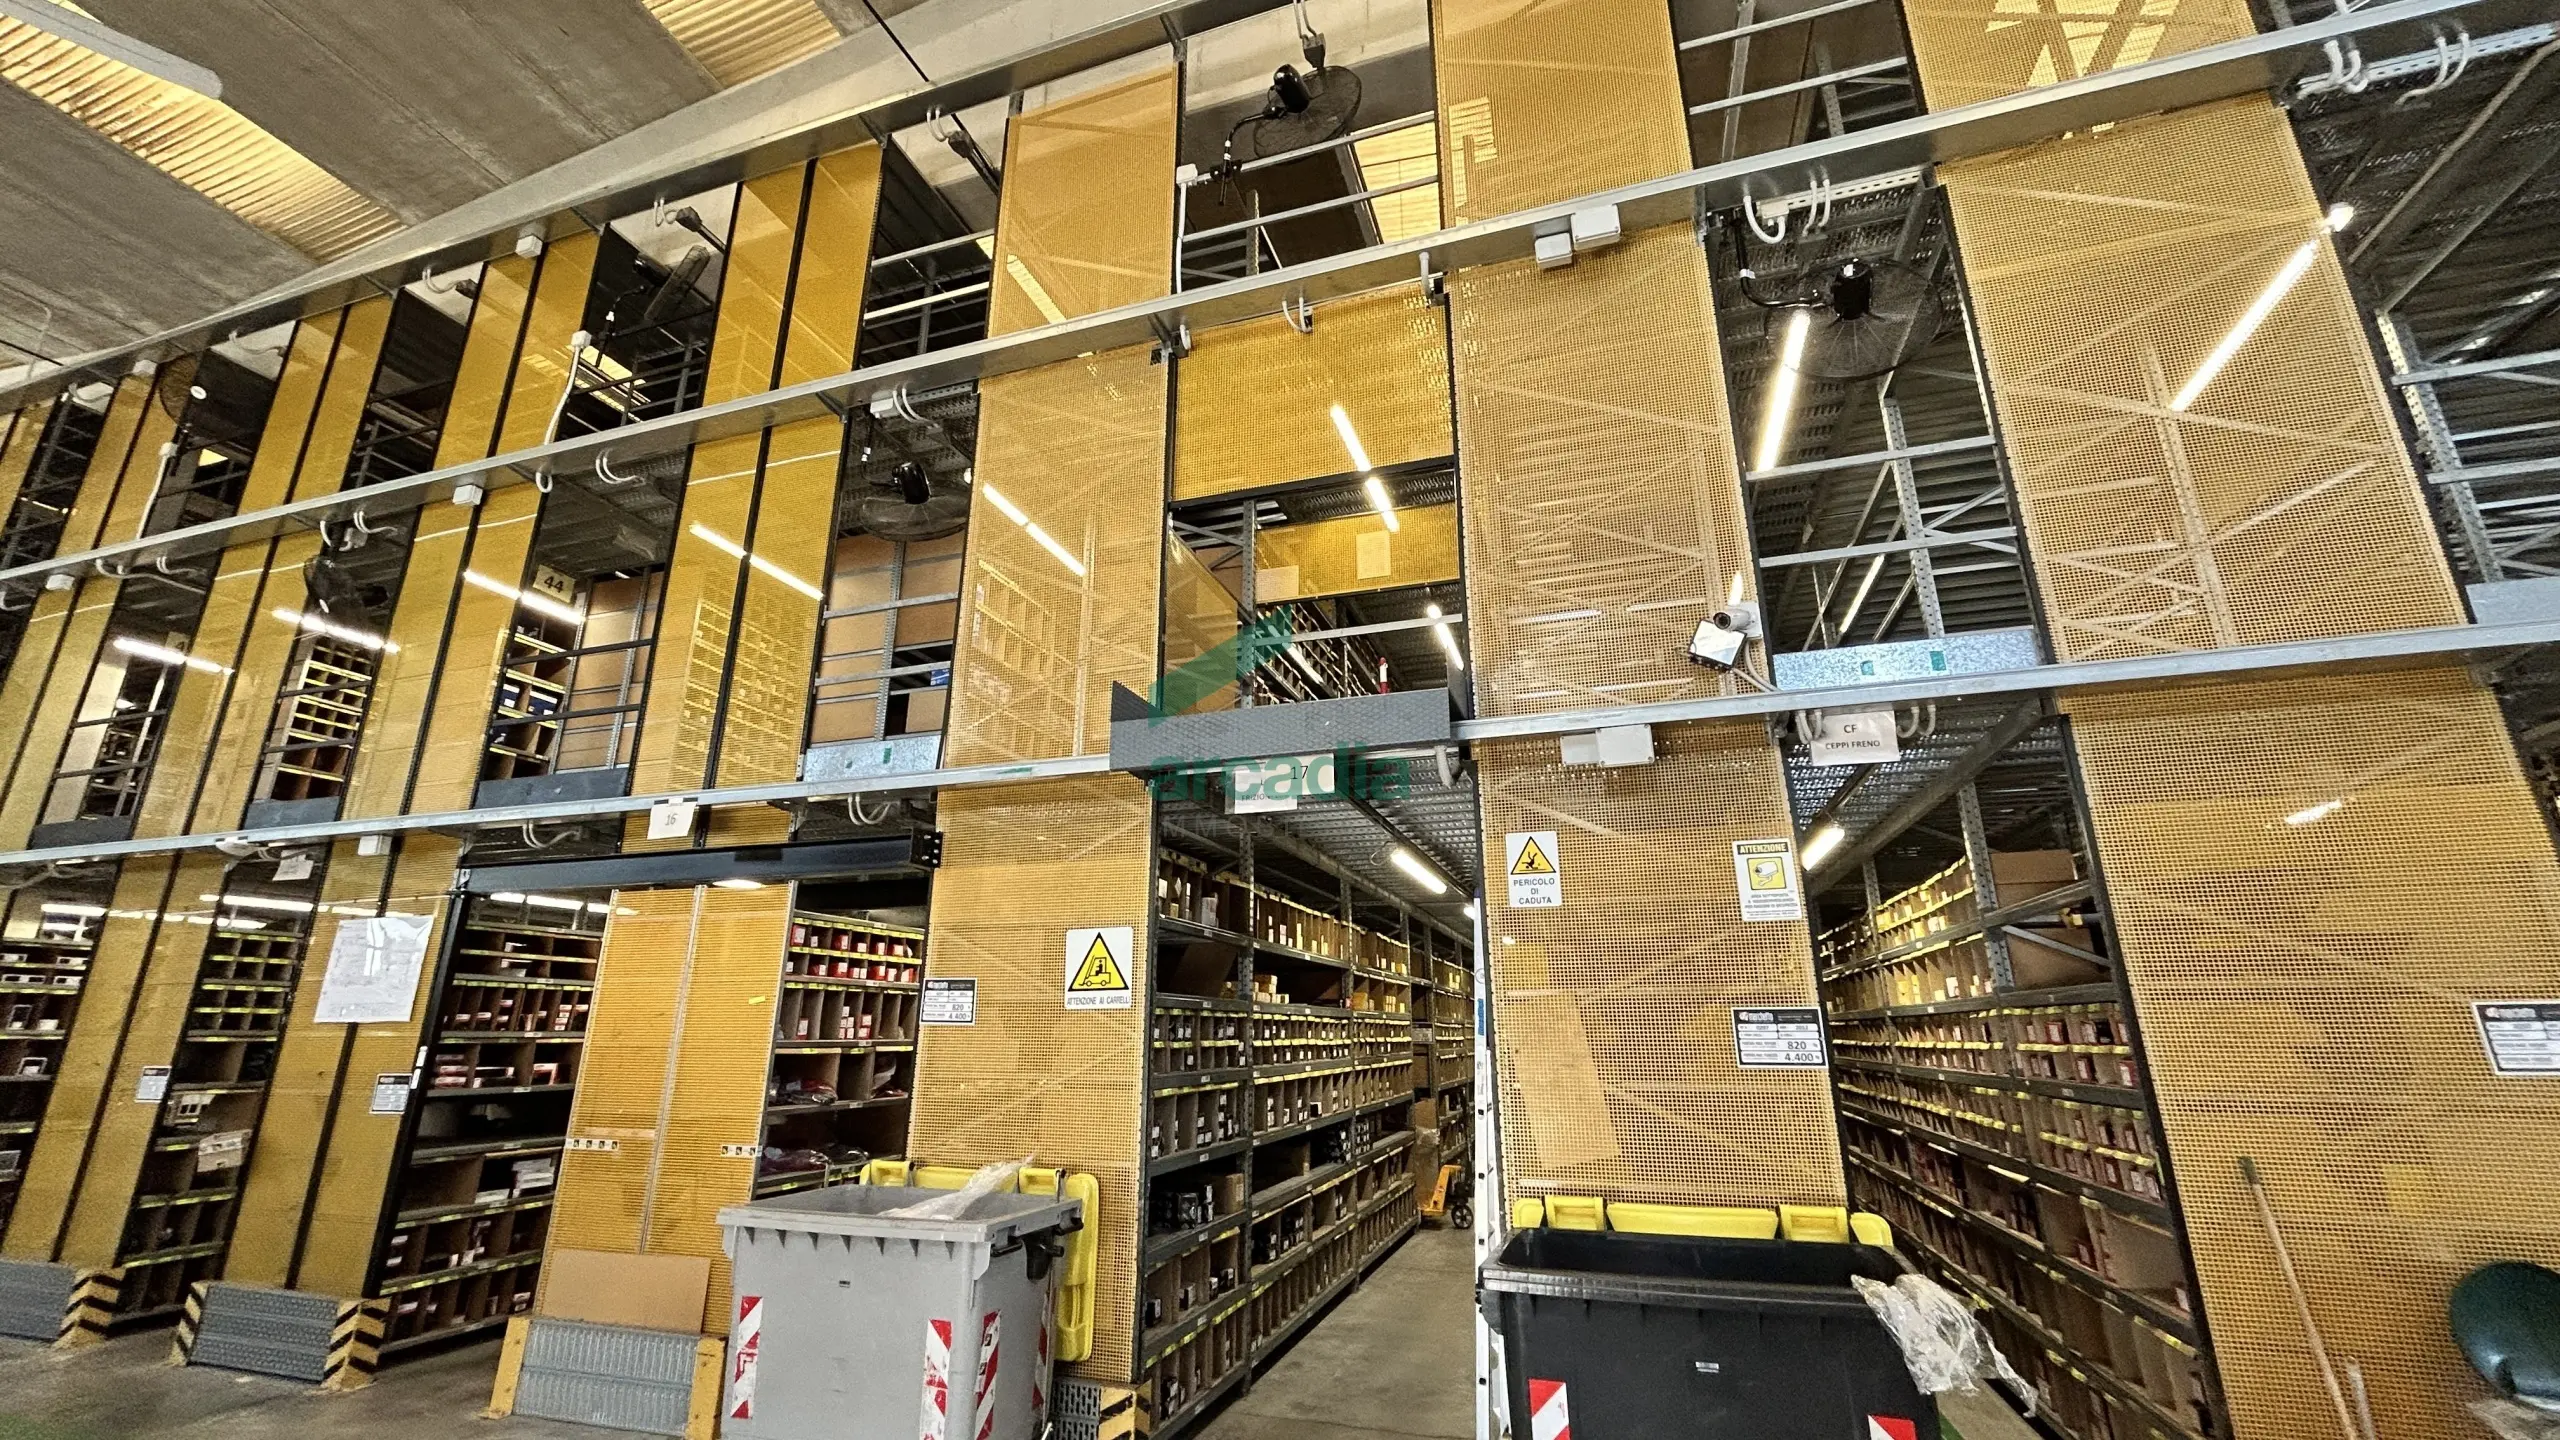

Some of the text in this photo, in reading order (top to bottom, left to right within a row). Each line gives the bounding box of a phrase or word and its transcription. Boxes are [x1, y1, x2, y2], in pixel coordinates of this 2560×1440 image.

[544, 576, 564, 593] 44
[1843, 724, 1857, 734] CF
[1825, 740, 1880, 750] CEPPI FRENO
[1290, 765, 1308, 780] 17
[665, 813, 678, 826] 16
[1739, 843, 1786, 854] ATTENZIONE
[1513, 878, 1555, 886] PERICOLO
[1519, 897, 1552, 905] CADUTA
[1067, 995, 1130, 1005] ATTENZIONE AI CARRELLI
[1787, 1041, 1807, 1050] 820
[1784, 1053, 1814, 1062] 4.400
